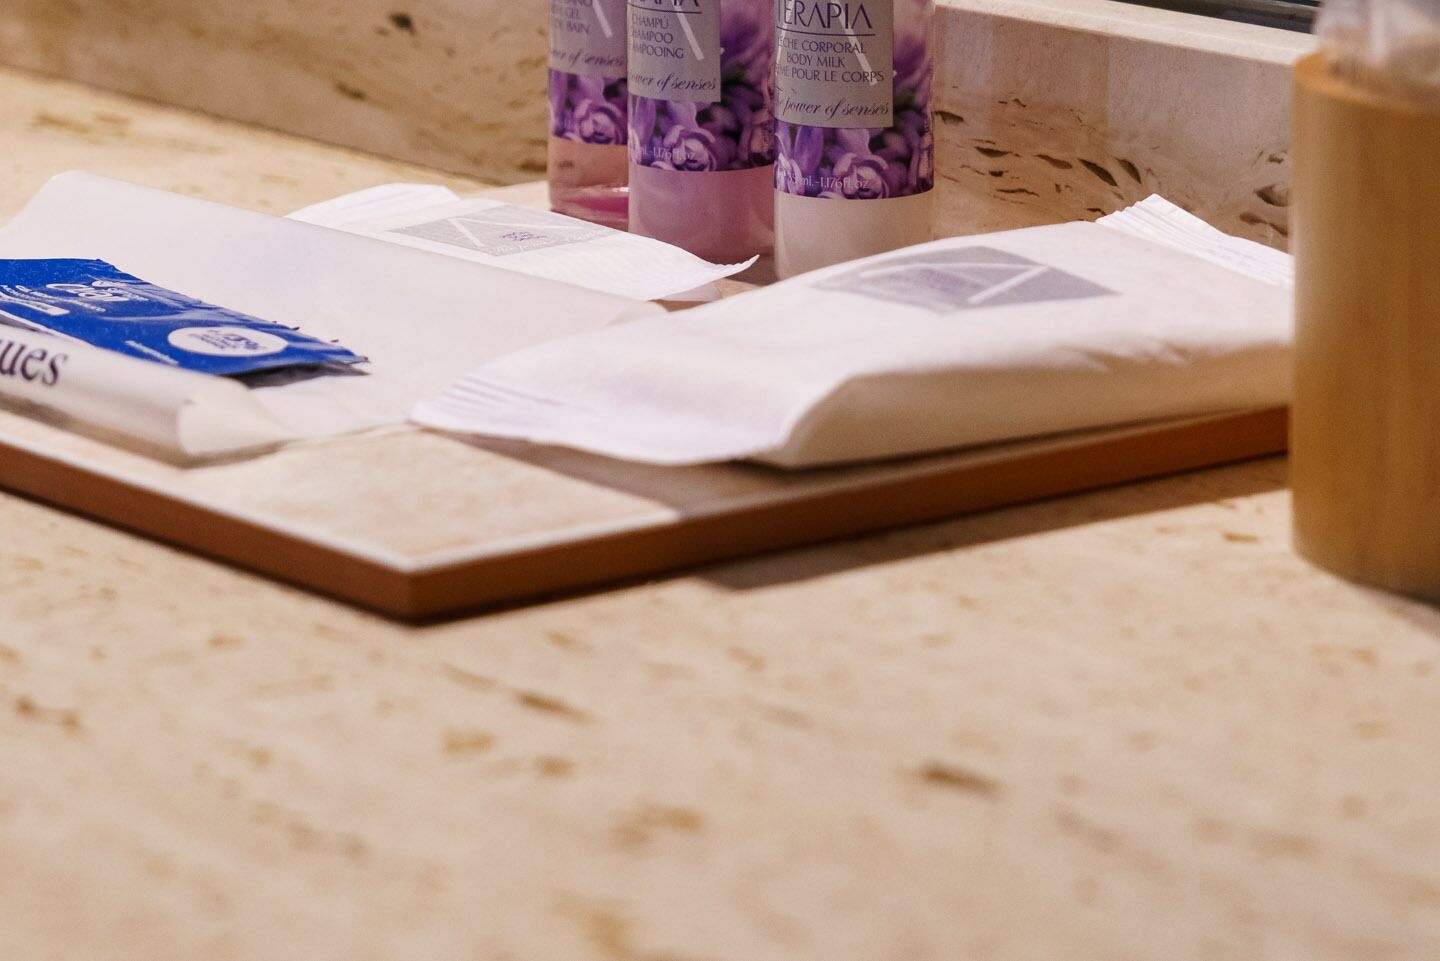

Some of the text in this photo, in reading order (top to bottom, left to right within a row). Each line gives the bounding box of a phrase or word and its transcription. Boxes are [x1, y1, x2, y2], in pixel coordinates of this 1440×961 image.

[801, 40, 868, 55] CORPORAL
[786, 52, 846, 69] BODY MILK
[791, 67, 820, 81] POUR
[824, 70, 838, 83] LE
[841, 71, 885, 83] CORPS
[671, 77, 717, 91] senses
[782, 97, 822, 117] power
[824, 98, 844, 120] of
[842, 100, 890, 117] senses
